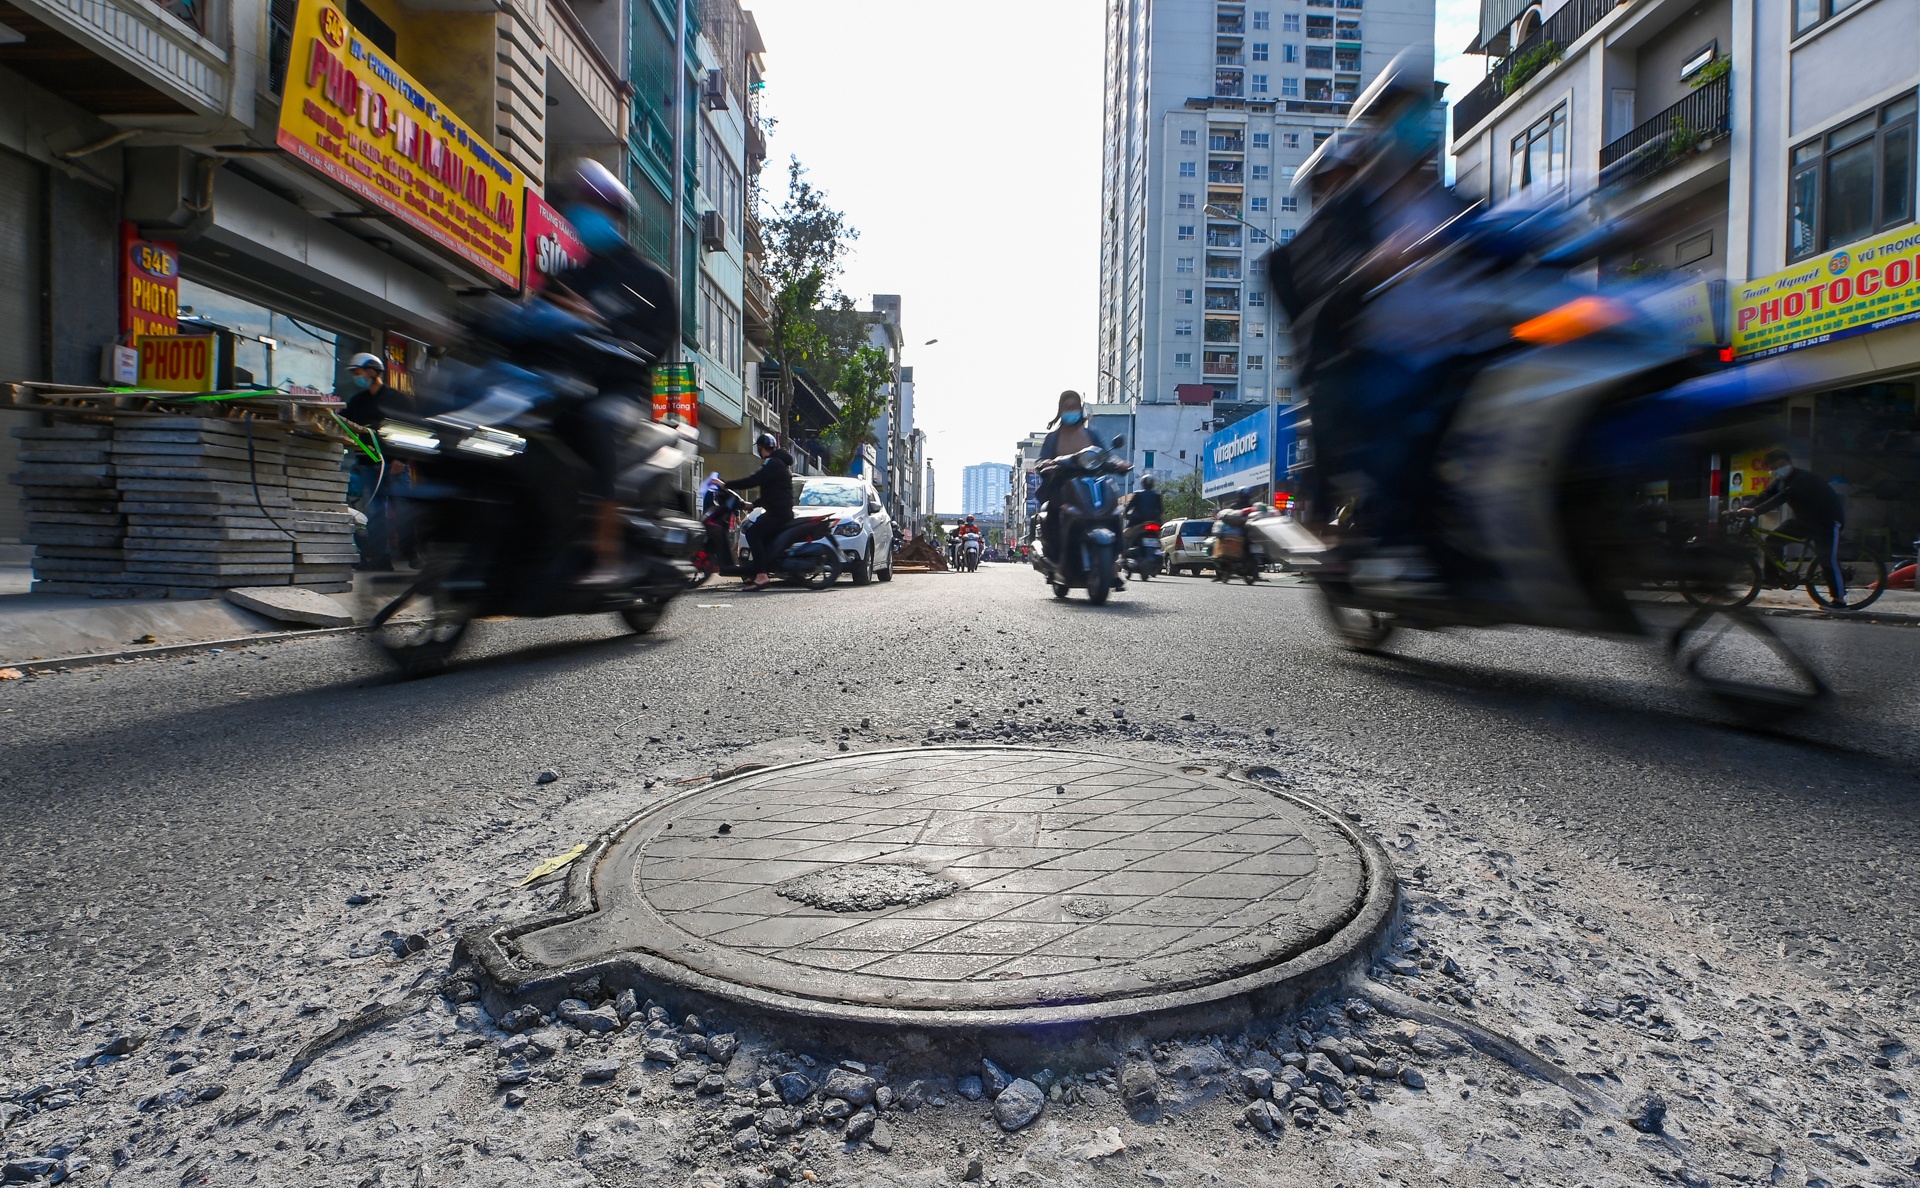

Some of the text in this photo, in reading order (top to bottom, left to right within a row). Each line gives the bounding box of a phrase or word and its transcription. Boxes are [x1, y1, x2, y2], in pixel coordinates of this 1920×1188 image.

[325, 9, 343, 47] 54E
[368, 52, 400, 94] PHOTO
[420, 128, 463, 195] MÀU
[142, 246, 171, 276] 54E
[1831, 255, 1849, 272] 53
[1858, 248, 1875, 262] VŨ
[132, 276, 177, 319] PHOTO
[1737, 253, 1920, 332] PHOTOCO
[142, 341, 206, 381] PHOTO
[1213, 431, 1259, 466] vinaphone
